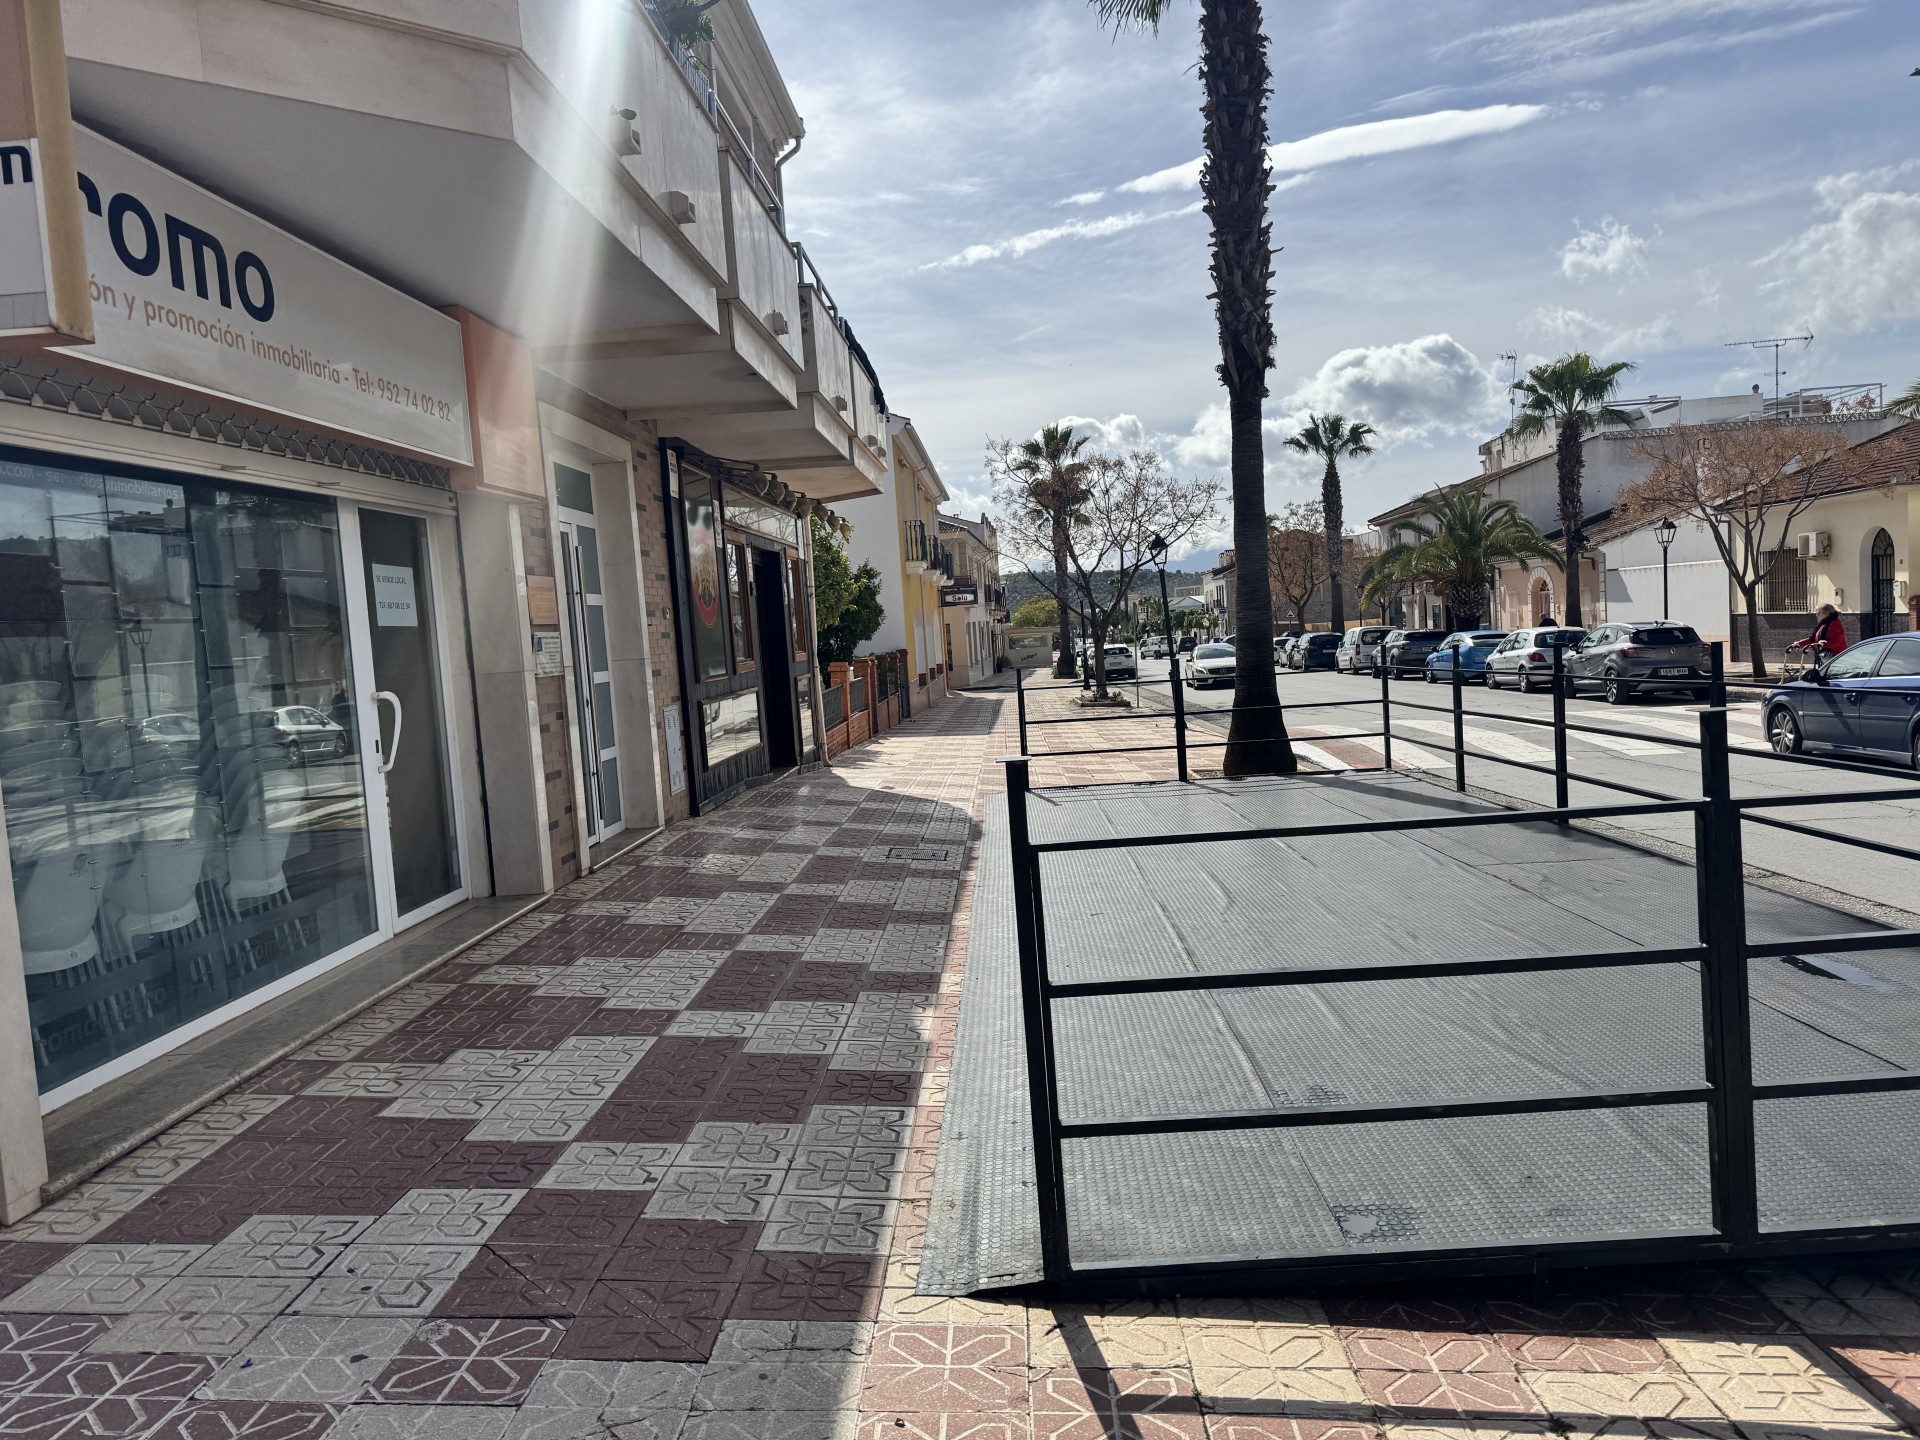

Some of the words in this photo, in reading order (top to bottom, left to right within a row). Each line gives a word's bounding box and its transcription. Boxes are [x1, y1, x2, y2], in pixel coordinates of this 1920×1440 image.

[123, 292, 135, 320] y
[144, 300, 246, 351] promoción
[250, 331, 340, 384] inmobiliaria
[352, 367, 375, 395] Tel:
[378, 378, 401, 404] 952
[403, 387, 418, 410] 74
[421, 394, 435, 416] 02
[438, 400, 451, 422] 82
[0, 465, 35, 479] .com
